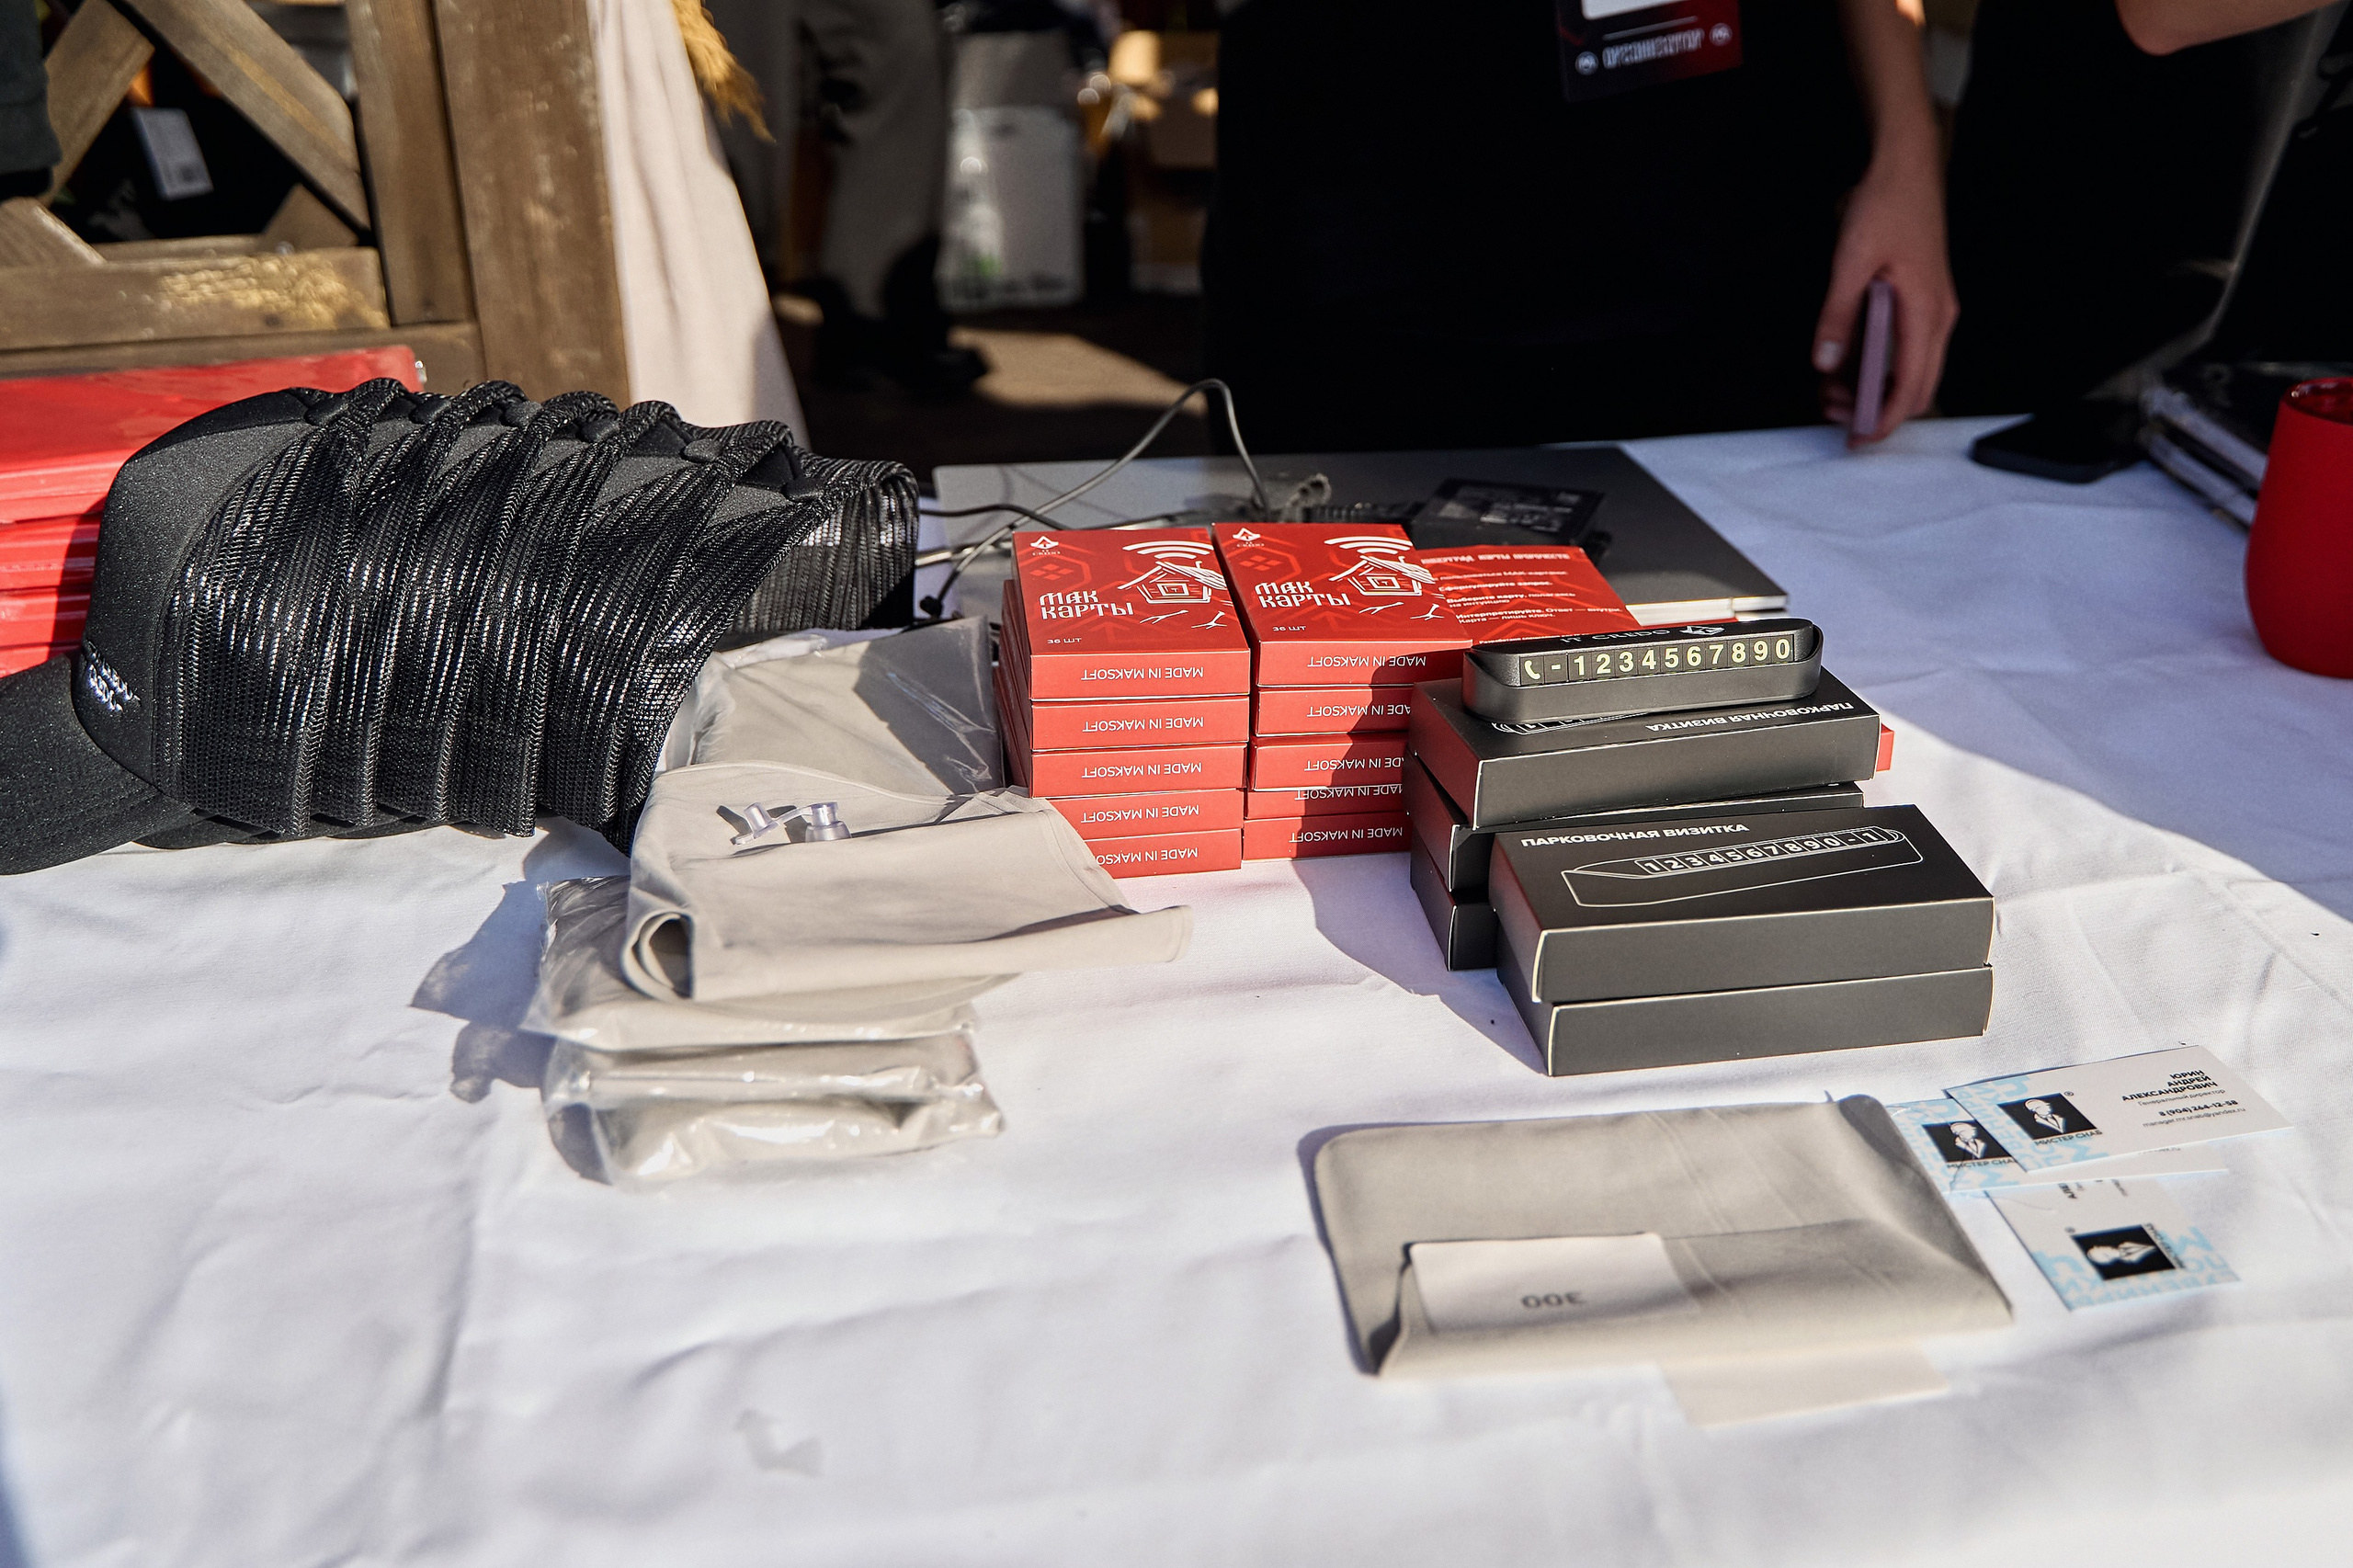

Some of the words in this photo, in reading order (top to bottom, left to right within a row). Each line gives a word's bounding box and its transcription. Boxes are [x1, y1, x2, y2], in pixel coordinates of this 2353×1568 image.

[1307, 656, 1370, 667] MAKSOFT
[1373, 655, 1386, 667] IN
[1389, 655, 1427, 667] MADE
[1080, 668, 1144, 681] MAKSOFT
[1148, 667, 1162, 679] IN
[1165, 666, 1204, 678] MADE
[1307, 705, 1369, 717] MAKSOFT
[1371, 704, 1384, 715] IN
[1387, 703, 1411, 715] ADE
[1728, 701, 1855, 723] ПАРКОВОЧНАЯ
[1082, 719, 1145, 732] MAKSOFT
[1149, 718, 1162, 730] IN
[1165, 717, 1204, 729] MADE
[1645, 715, 1728, 732] ВИЗИТКА
[1304, 758, 1366, 771] MAKSOFT
[1369, 757, 1381, 768] IN
[1385, 756, 1404, 768] DE
[1081, 766, 1144, 778] MAKSOFT
[1147, 764, 1161, 776] IN
[1164, 762, 1202, 775] MADE
[1294, 788, 1355, 801] MAKSOFT
[1357, 786, 1370, 797] IN
[1080, 809, 1142, 823] MAKSOFT
[1145, 807, 1159, 819] IN
[1162, 804, 1199, 817] MADE
[1289, 830, 1348, 843] MAKSOFT
[1351, 828, 1364, 840] IN
[1367, 826, 1403, 839] MADE
[1520, 829, 1661, 847] ПАРКОВОЧНАЯ
[1663, 823, 1750, 838] ВИЗИТКА
[1094, 852, 1142, 865] MAKSO
[1145, 850, 1158, 862] IN
[1160, 847, 1198, 860] MADE
[2166, 1074, 2212, 1086] АНДРЕЙ
[2169, 1069, 2206, 1080] ЮРИН
[2121, 1081, 2219, 1102] АЛЕКСАНДРОВИЧ
[2034, 1135, 2075, 1146] МИСТЕР
[2075, 1130, 2103, 1141] СНАБ
